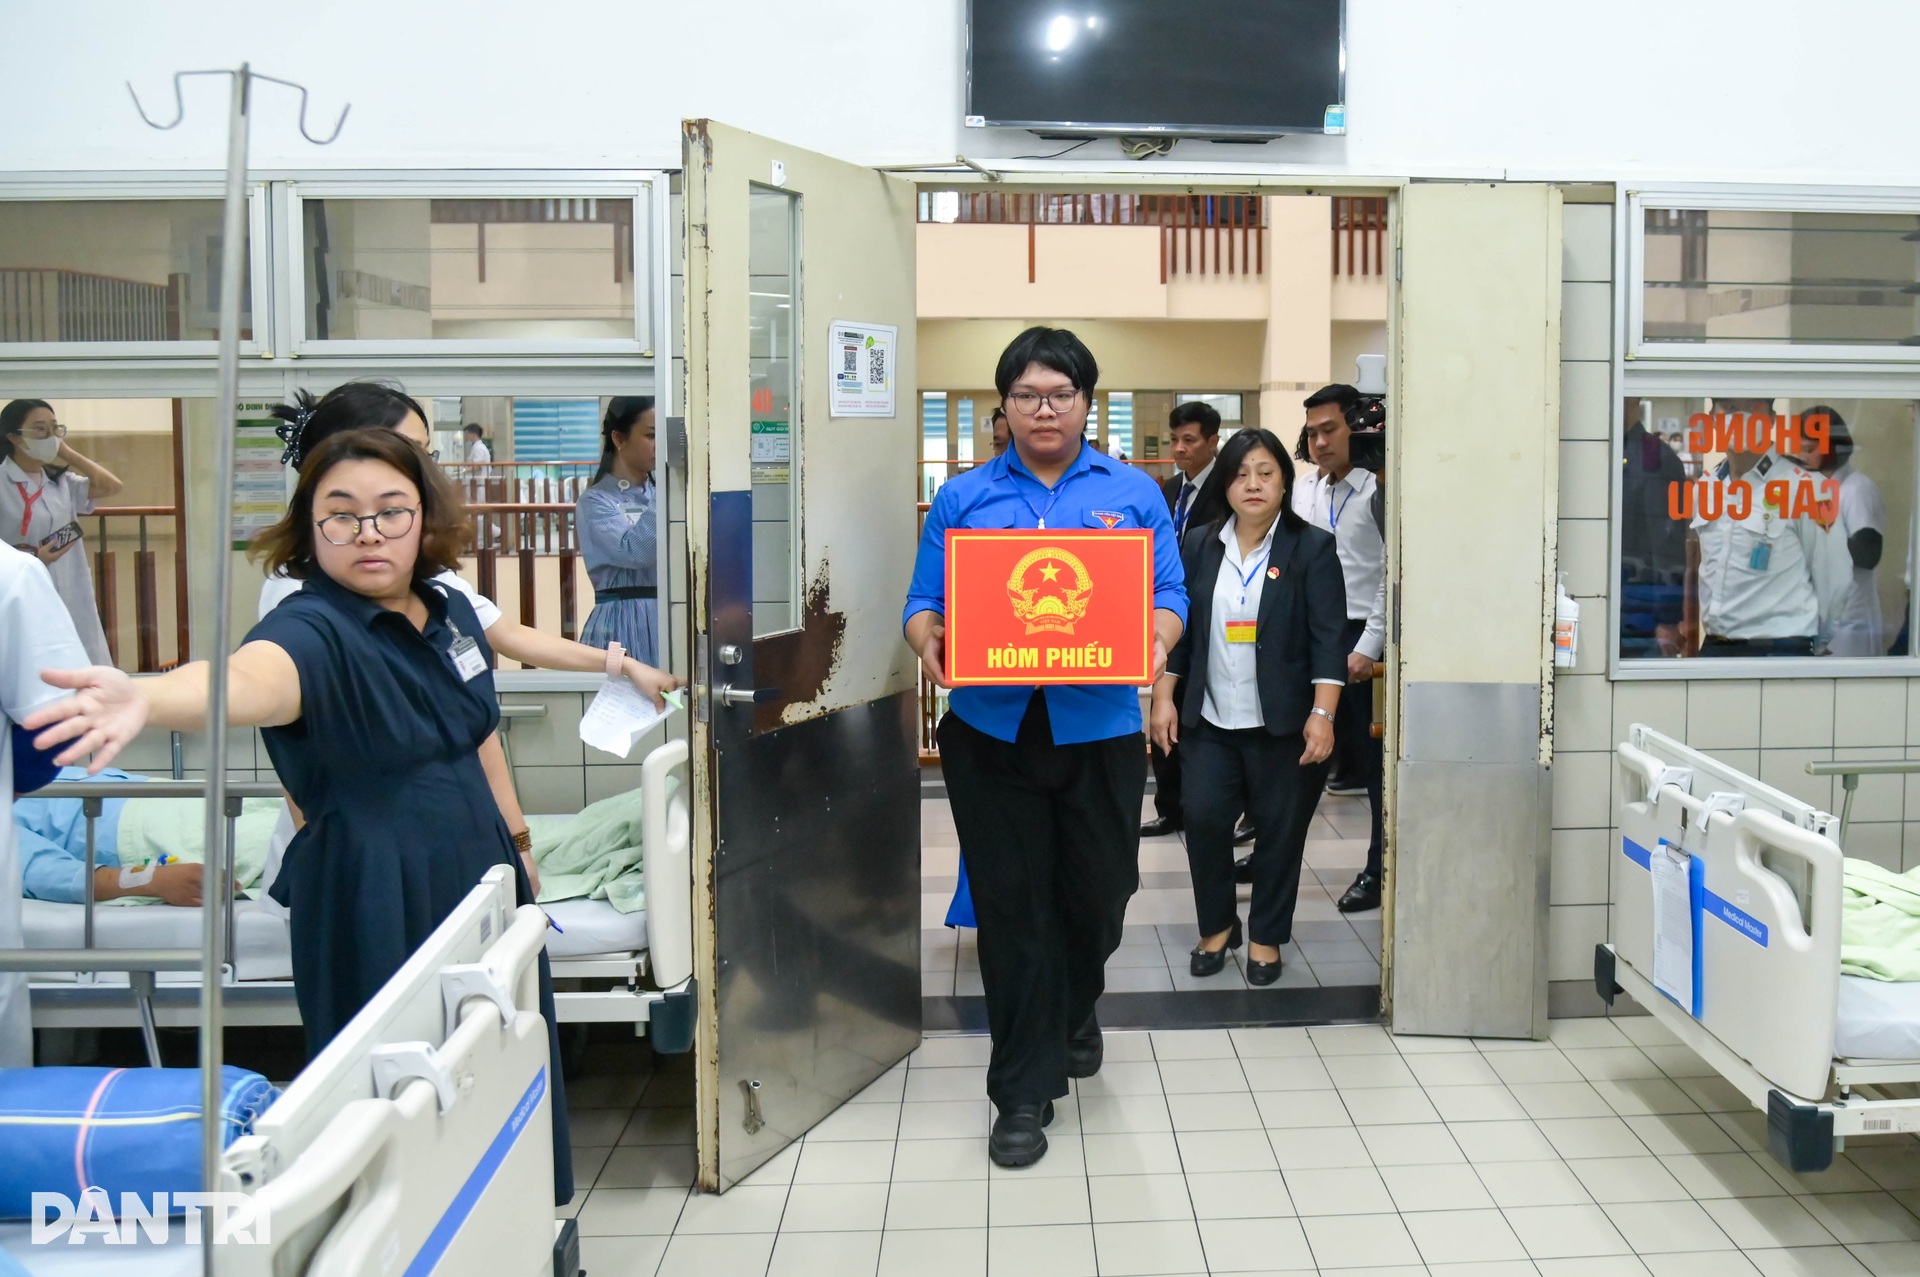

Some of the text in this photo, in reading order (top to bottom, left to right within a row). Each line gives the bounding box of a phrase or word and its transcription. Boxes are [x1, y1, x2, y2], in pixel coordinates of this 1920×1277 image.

[987, 640, 1112, 668] HÒM PHIẾU
[1723, 906, 1762, 938] Medical Master
